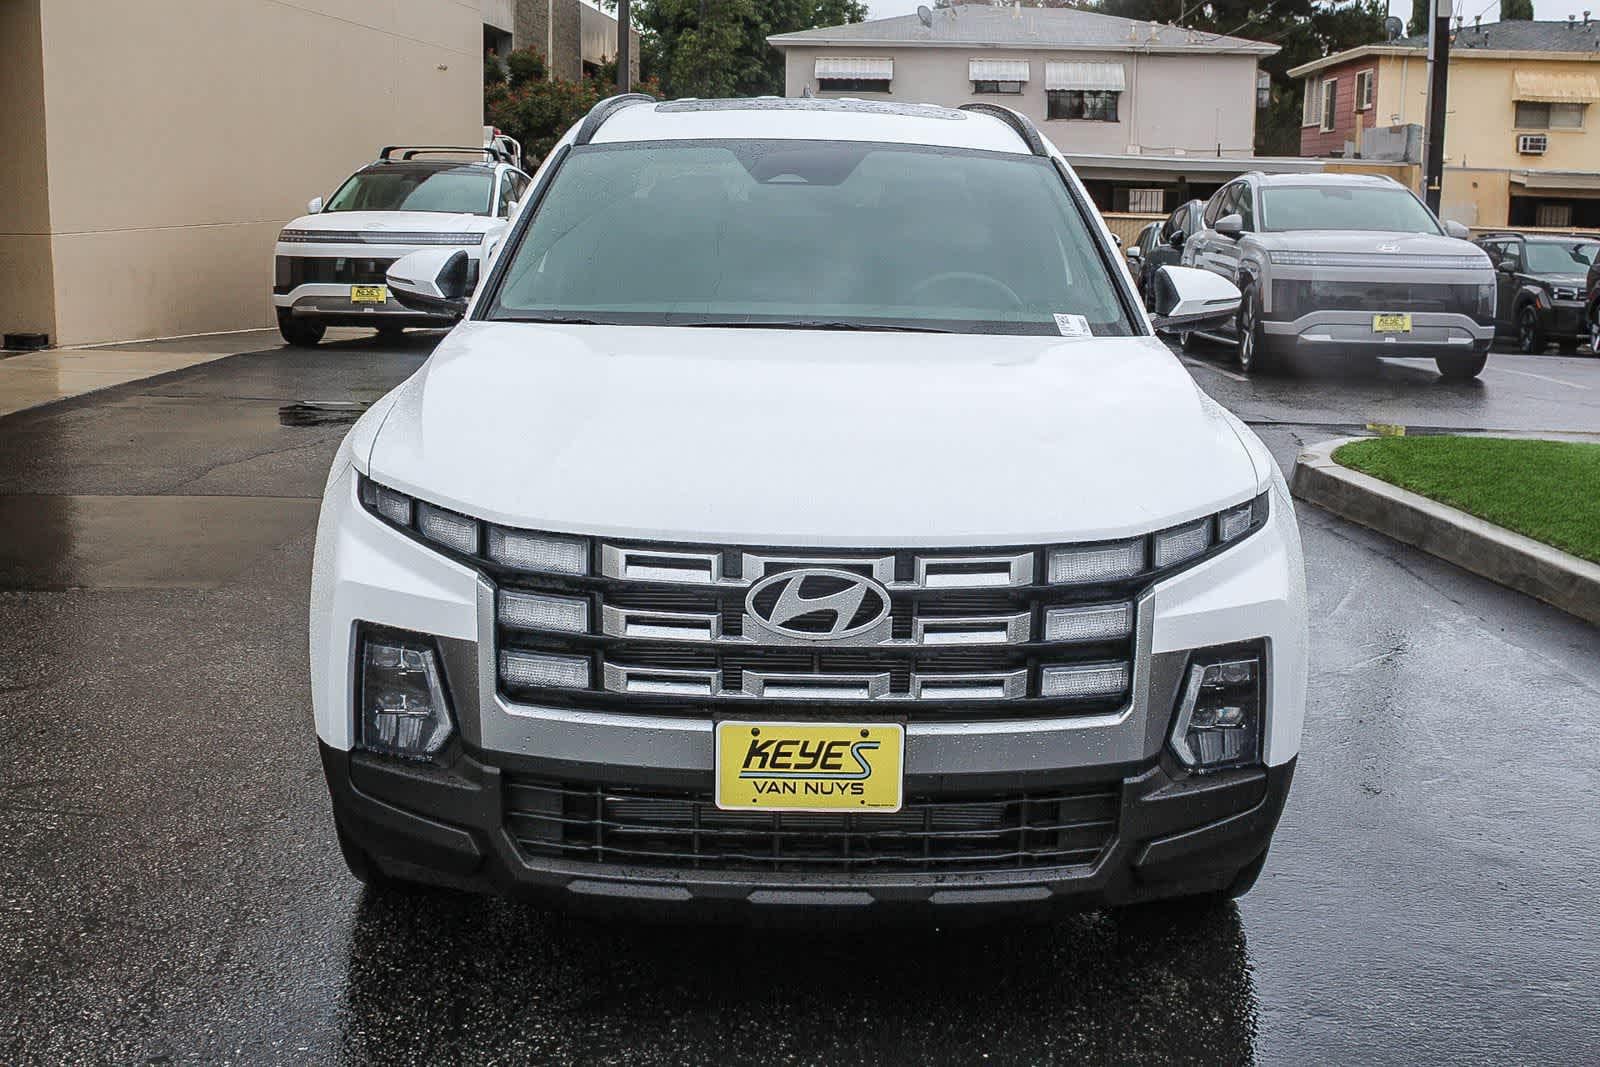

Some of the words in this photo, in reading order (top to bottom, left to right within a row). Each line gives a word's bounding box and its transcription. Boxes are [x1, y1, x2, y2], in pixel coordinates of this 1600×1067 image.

[740, 739, 880, 780] KEYES
[753, 781, 796, 795] VAN
[804, 782, 864, 795] NUYS
